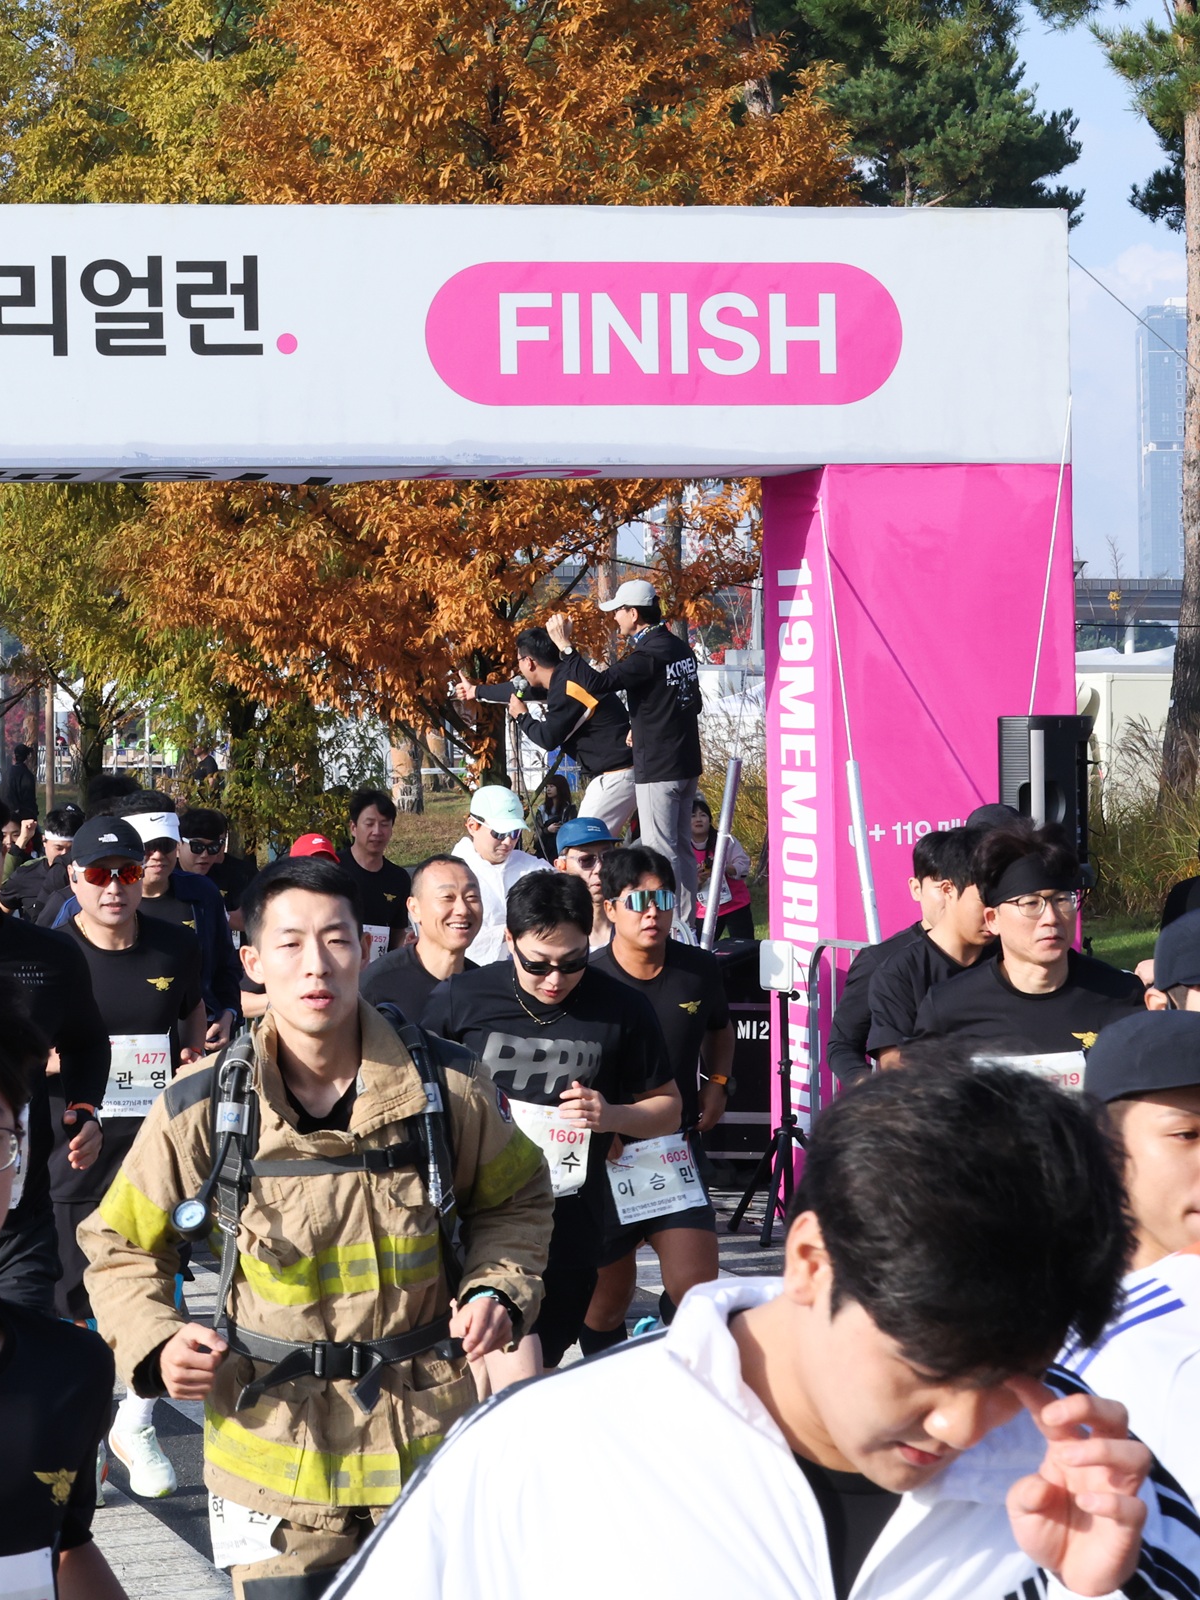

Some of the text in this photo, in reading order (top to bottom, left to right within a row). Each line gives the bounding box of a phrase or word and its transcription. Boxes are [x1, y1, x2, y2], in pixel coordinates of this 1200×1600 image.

[498, 291, 838, 377] FINISH
[891, 820, 932, 846] 119
[134, 1052, 167, 1064] 1477
[549, 1128, 585, 1145] 1601
[561, 1151, 581, 1173] 수
[660, 1149, 688, 1164] 1603
